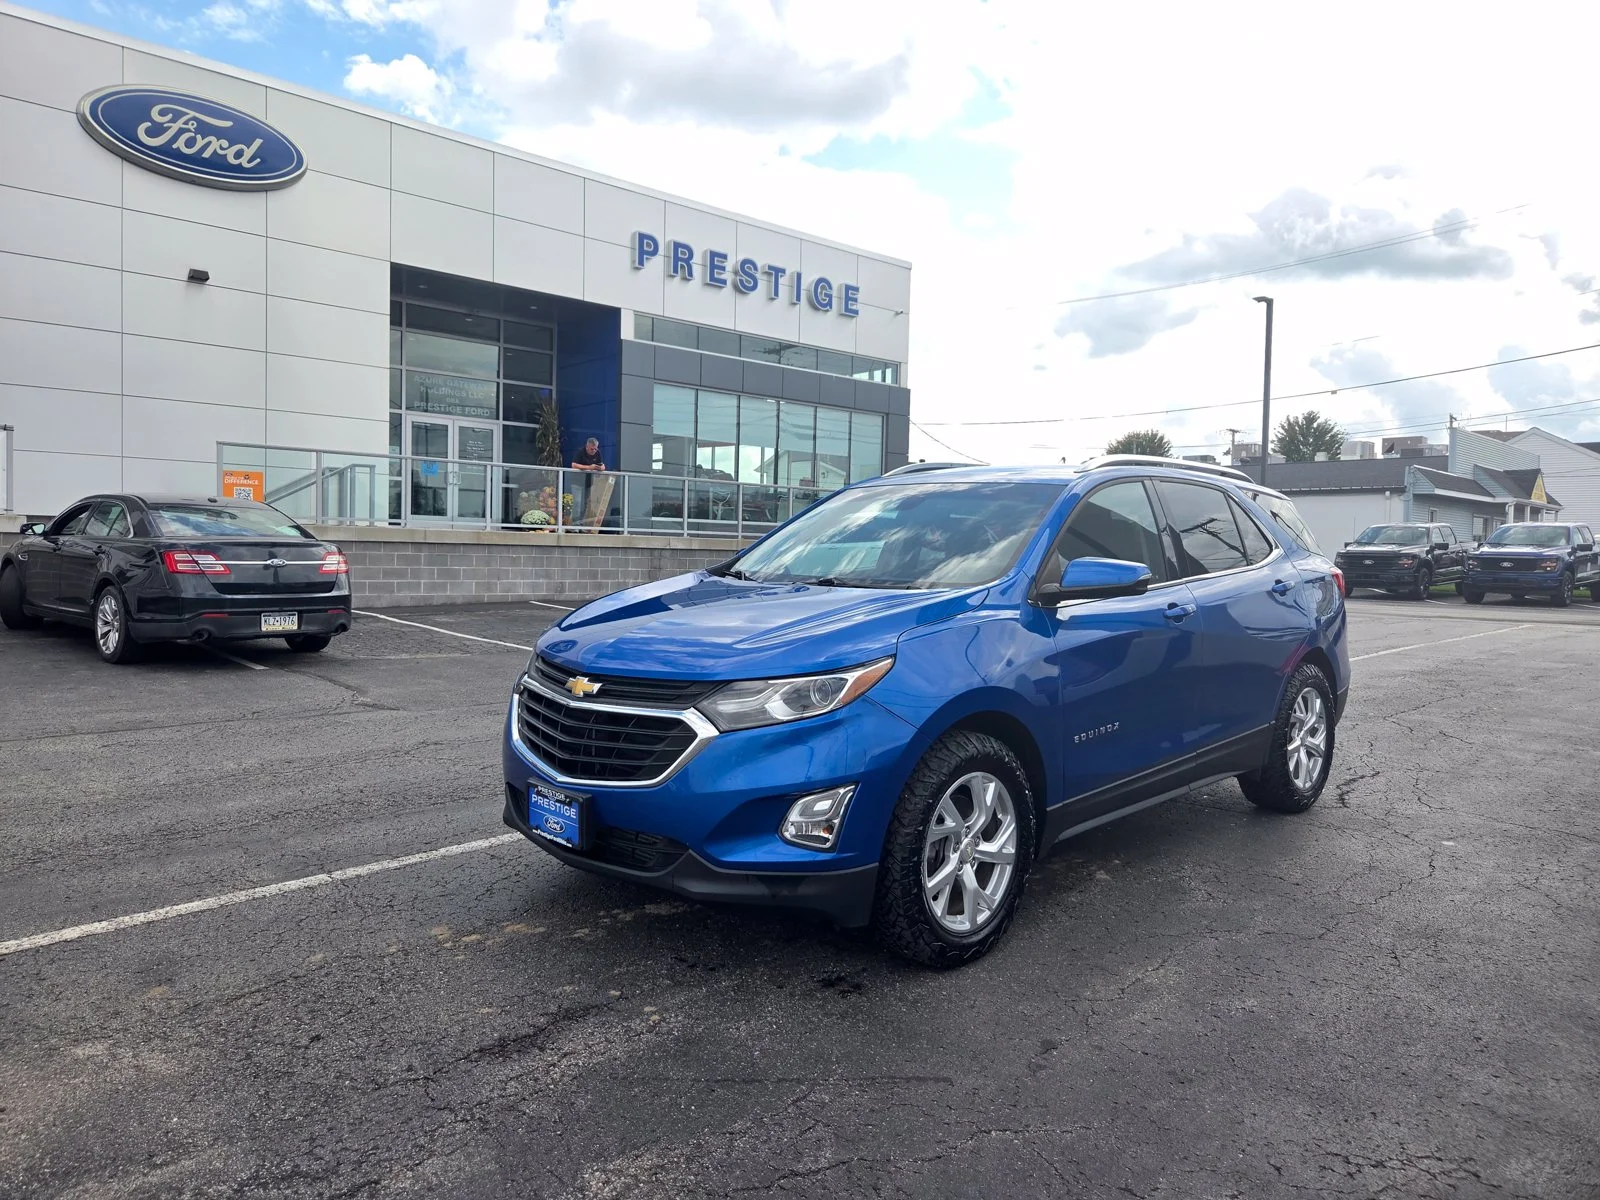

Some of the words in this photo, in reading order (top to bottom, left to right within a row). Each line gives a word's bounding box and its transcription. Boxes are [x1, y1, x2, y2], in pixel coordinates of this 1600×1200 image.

[137, 104, 264, 168] Ford
[632, 231, 860, 317] PRESTIGE
[414, 401, 463, 414] PRESTIGE
[465, 406, 490, 416] FORD
[1074, 721, 1119, 743] EQUINOX
[531, 794, 576, 819] PRESTIGE
[547, 816, 561, 831] Ford
